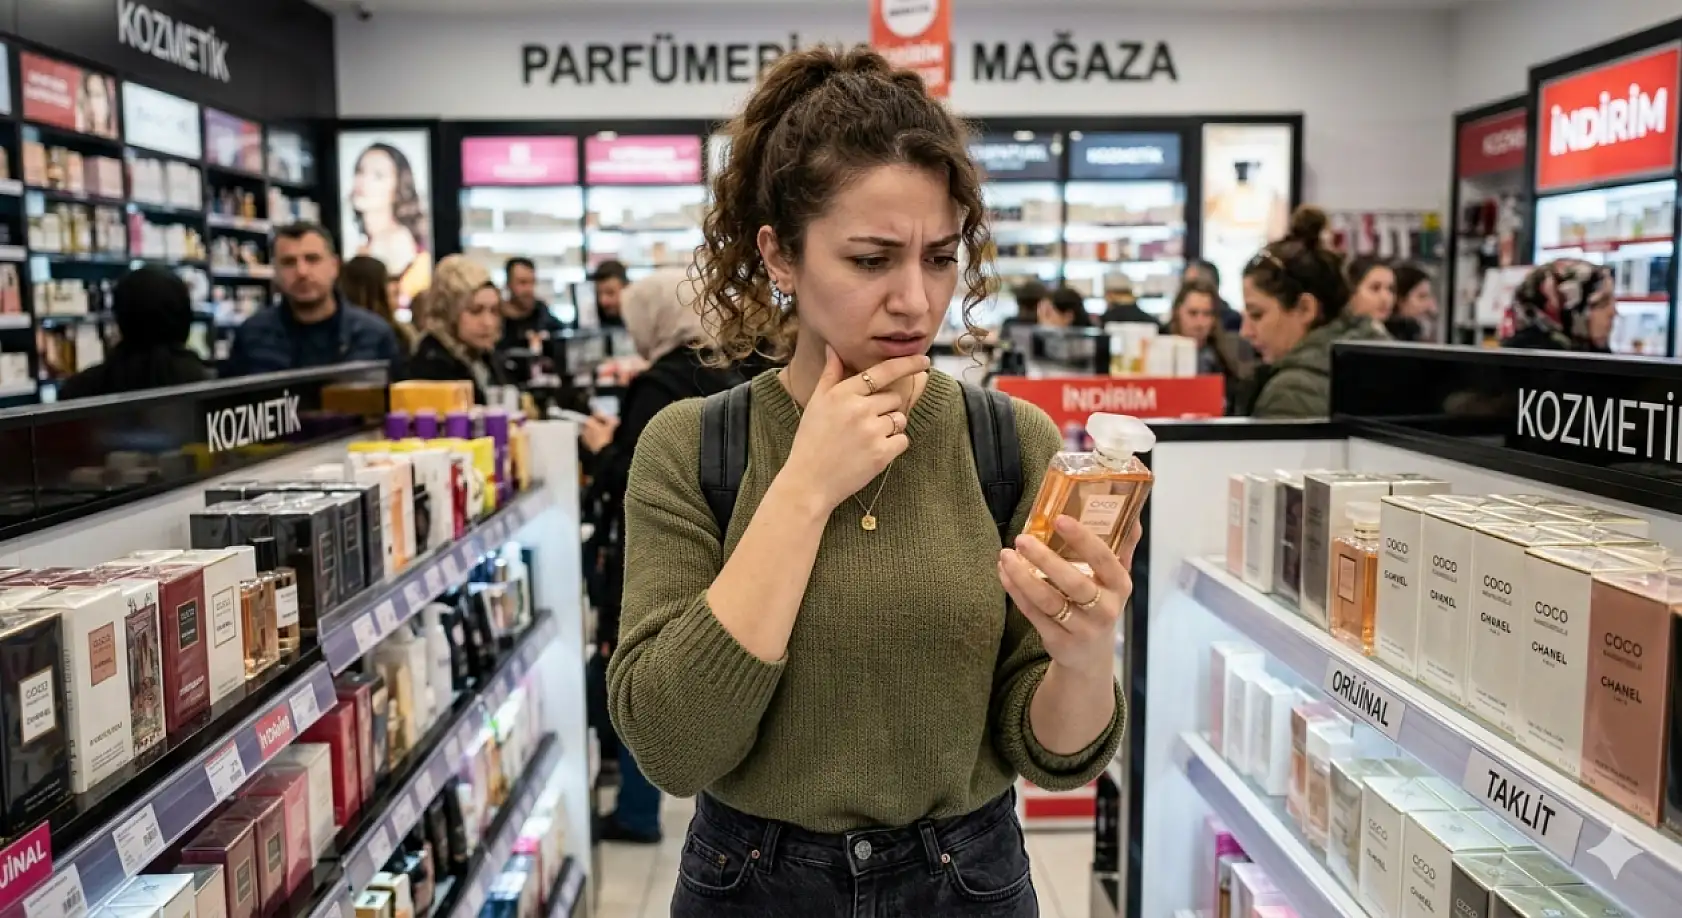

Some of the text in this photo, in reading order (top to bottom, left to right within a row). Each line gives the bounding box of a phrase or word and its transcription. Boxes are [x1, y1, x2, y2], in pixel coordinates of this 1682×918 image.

[117, 0, 230, 83] KOZMETİK
[520, 32, 799, 84] PARFÜMER
[972, 28, 1178, 82] MAĞAZA
[1550, 83, 1667, 156] İNDİRİM
[1062, 383, 1157, 412] İNDİRİM
[206, 388, 301, 454] KOZMETİK
[1517, 387, 1682, 464] KOZMETİ
[1432, 554, 1457, 573] COCO
[1483, 574, 1512, 595] COCO
[1535, 600, 1568, 624] COCO
[1531, 640, 1568, 666] CHANEL
[1604, 632, 1643, 658] COCO
[1332, 669, 1389, 727] ORİJİNAL
[1600, 675, 1643, 704] CHANEL
[1487, 768, 1556, 836] TAKLİT
